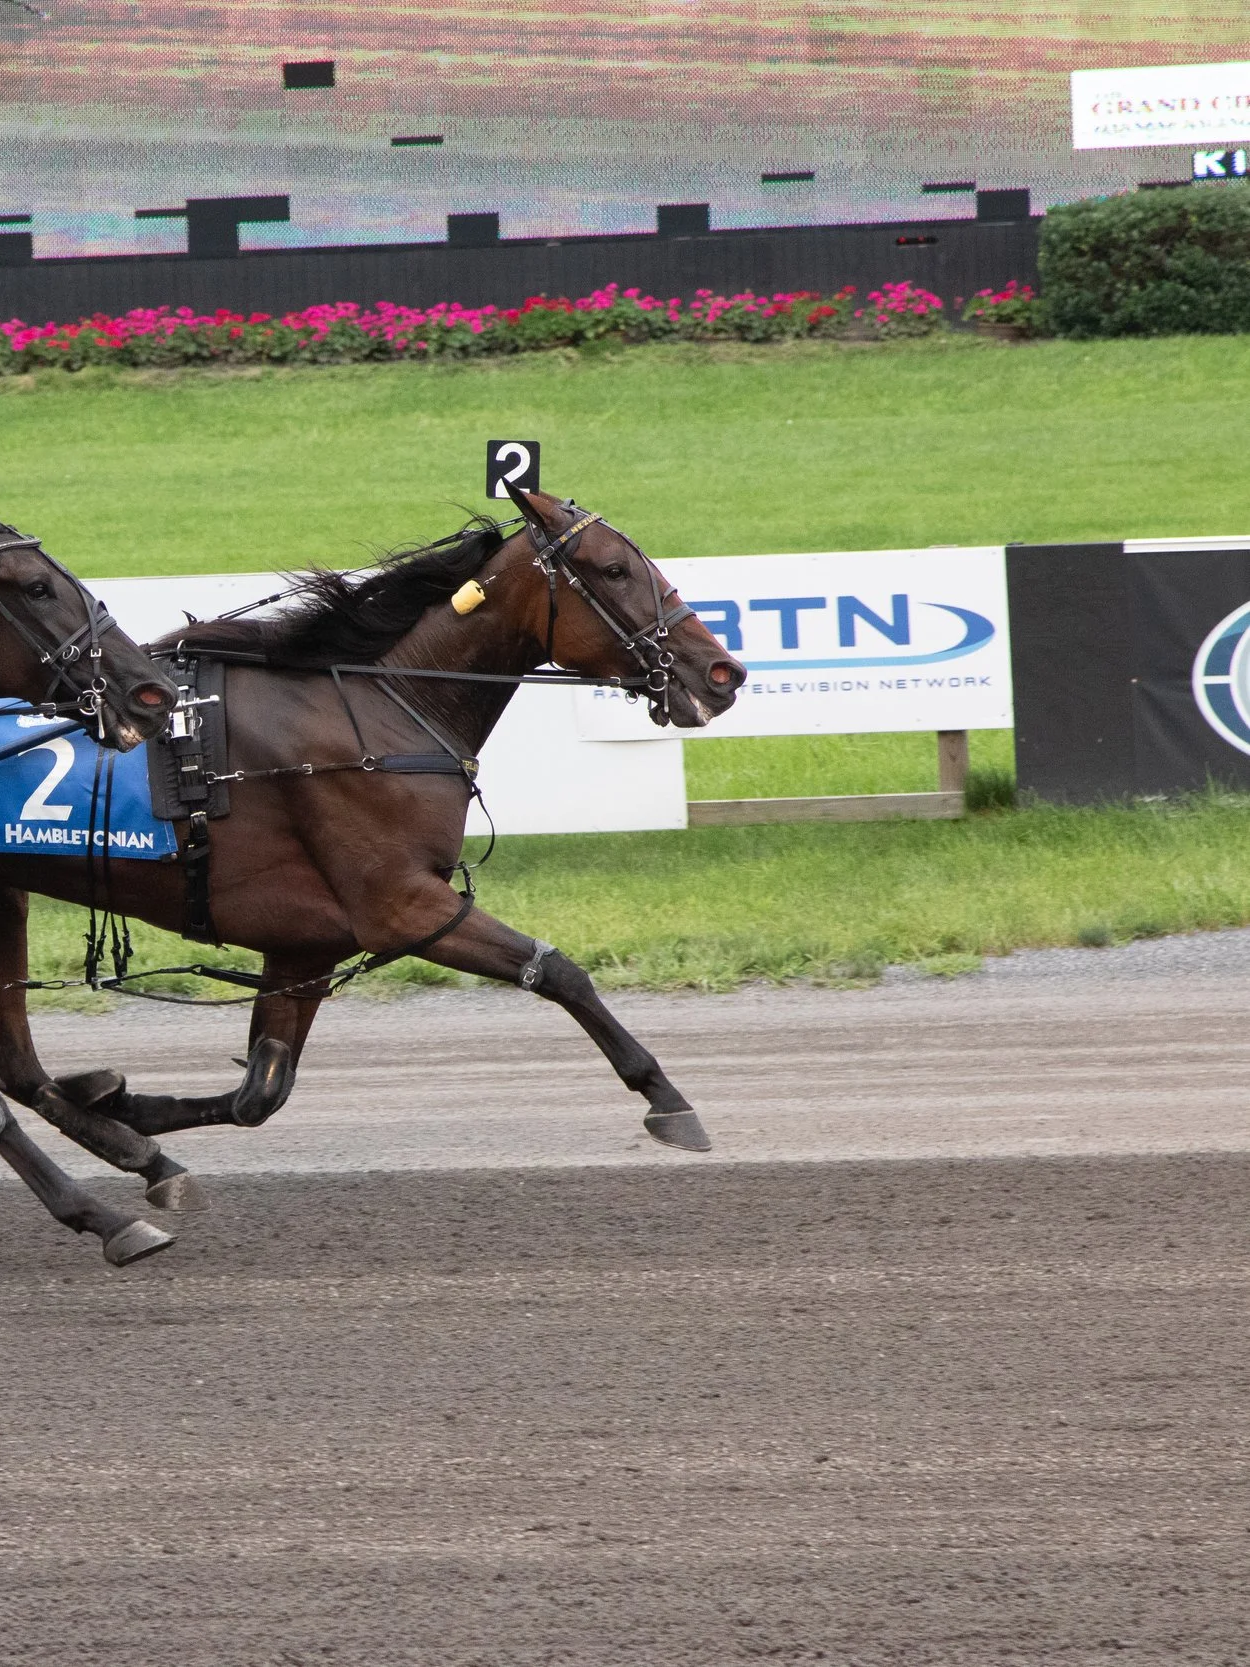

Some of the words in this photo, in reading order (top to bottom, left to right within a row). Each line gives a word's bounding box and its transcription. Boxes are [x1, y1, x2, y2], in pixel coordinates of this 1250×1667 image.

[495, 442, 530, 498] 2
[879, 676, 993, 691] NETWORK
[17, 736, 75, 821] 2
[4, 823, 154, 849] HAMBLETONIAN
